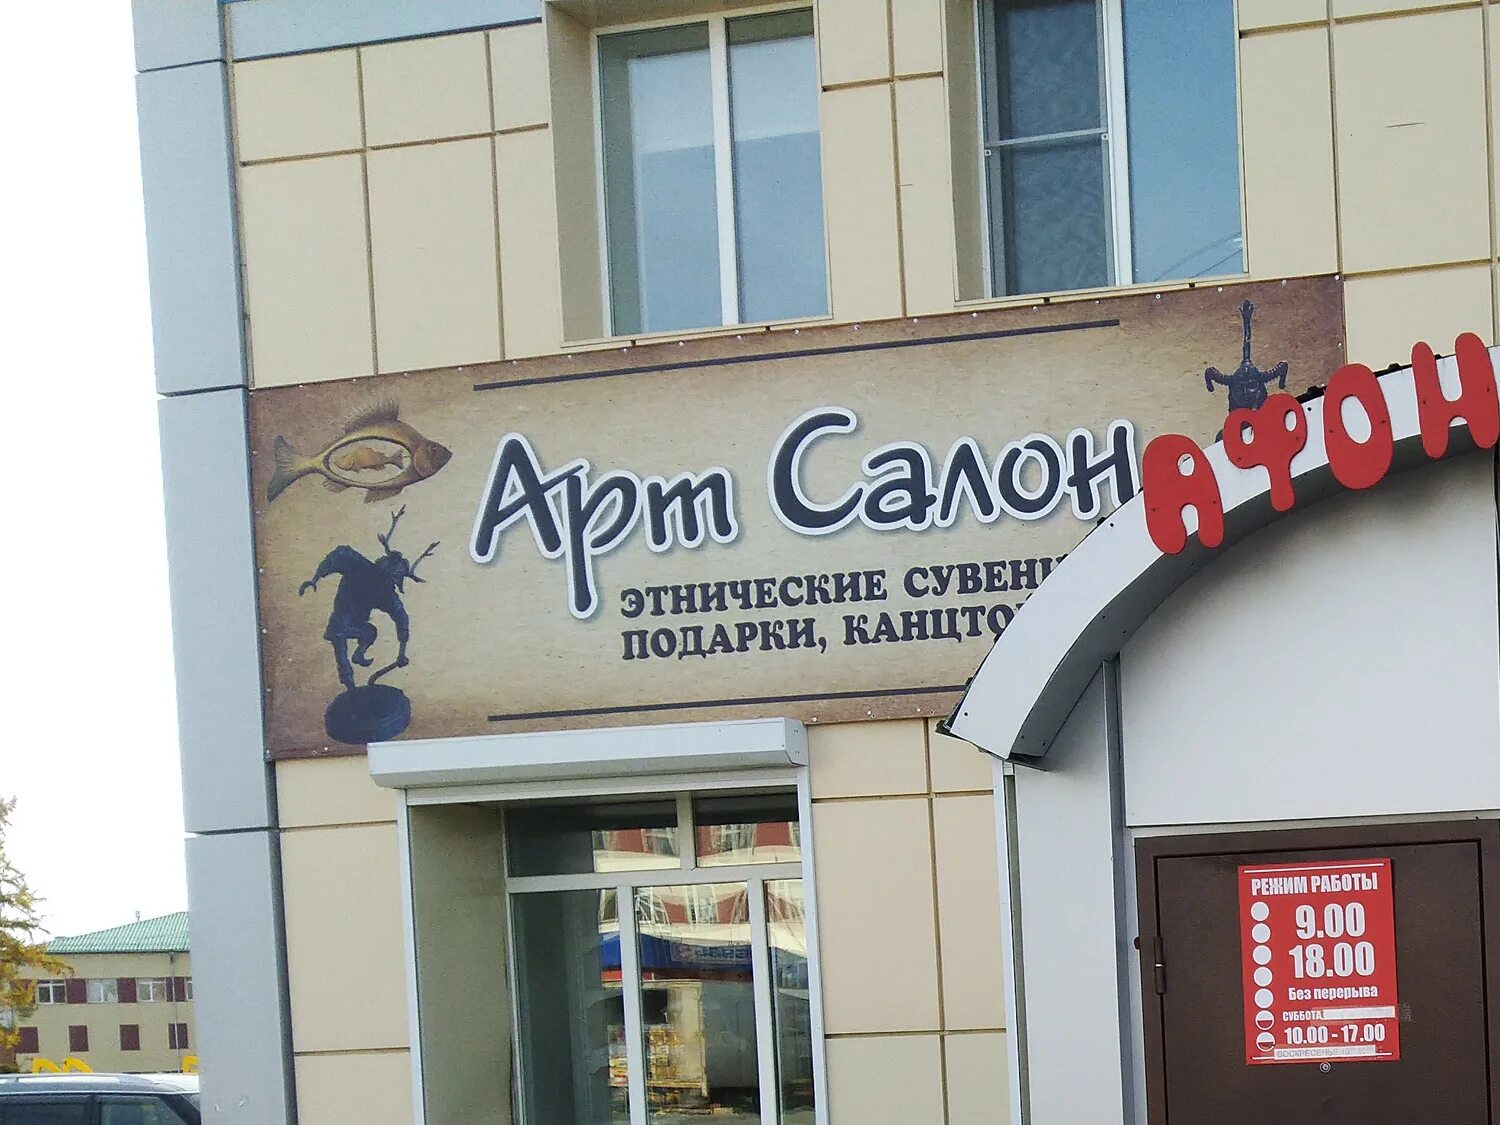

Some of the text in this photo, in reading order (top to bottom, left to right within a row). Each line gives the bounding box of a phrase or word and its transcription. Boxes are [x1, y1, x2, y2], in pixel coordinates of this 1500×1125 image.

[469, 406, 1142, 620] Арт Салон
[620, 568, 887, 619] ЭТНИЧЕСКИЕ
[621, 602, 1024, 661] ПОДАРКИ, КАНЦТО
[1251, 872, 1378, 896] РЕЖИМ РАБОТЫ
[1295, 902, 1366, 940] 9.00
[1288, 941, 1375, 979] 18.00
[1288, 986, 1379, 1001] Без перерыва
[1284, 1025, 1329, 1045] 10.00
[1341, 1023, 1386, 1043] 17.00
